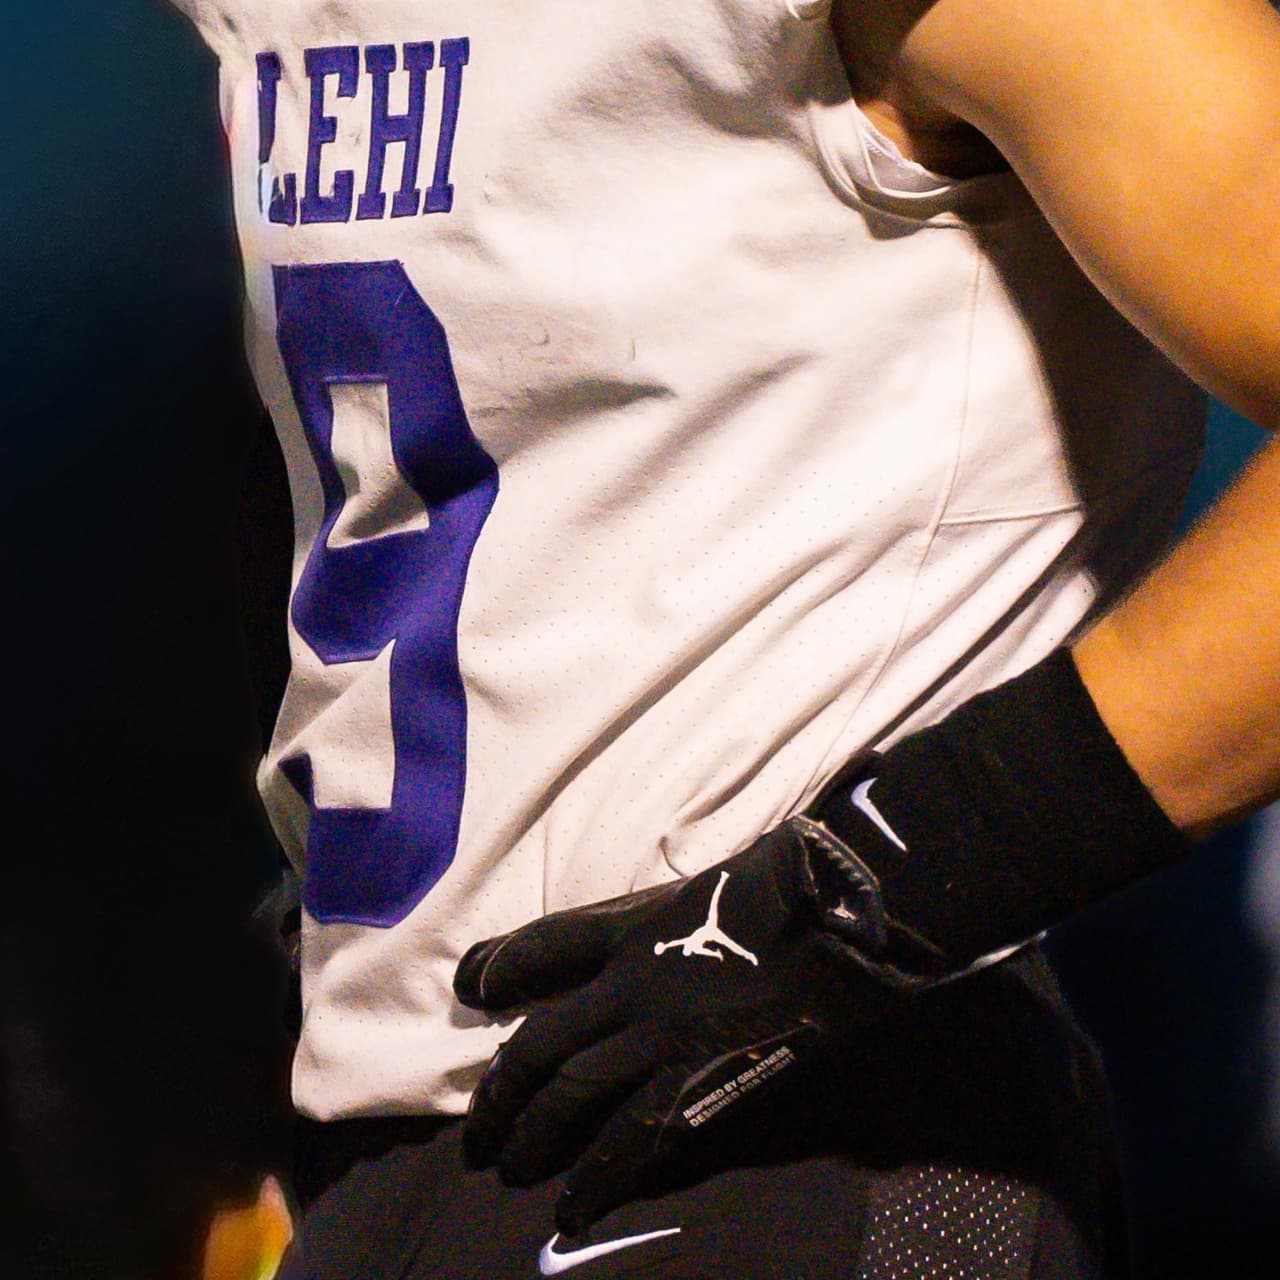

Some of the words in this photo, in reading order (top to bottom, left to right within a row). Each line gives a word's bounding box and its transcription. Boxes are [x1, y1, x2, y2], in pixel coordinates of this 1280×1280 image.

[256, 37, 470, 226] LEHI
[271, 260, 500, 928] 9
[683, 1088, 725, 1119] INSPIRED
[724, 1080, 737, 1093] BY
